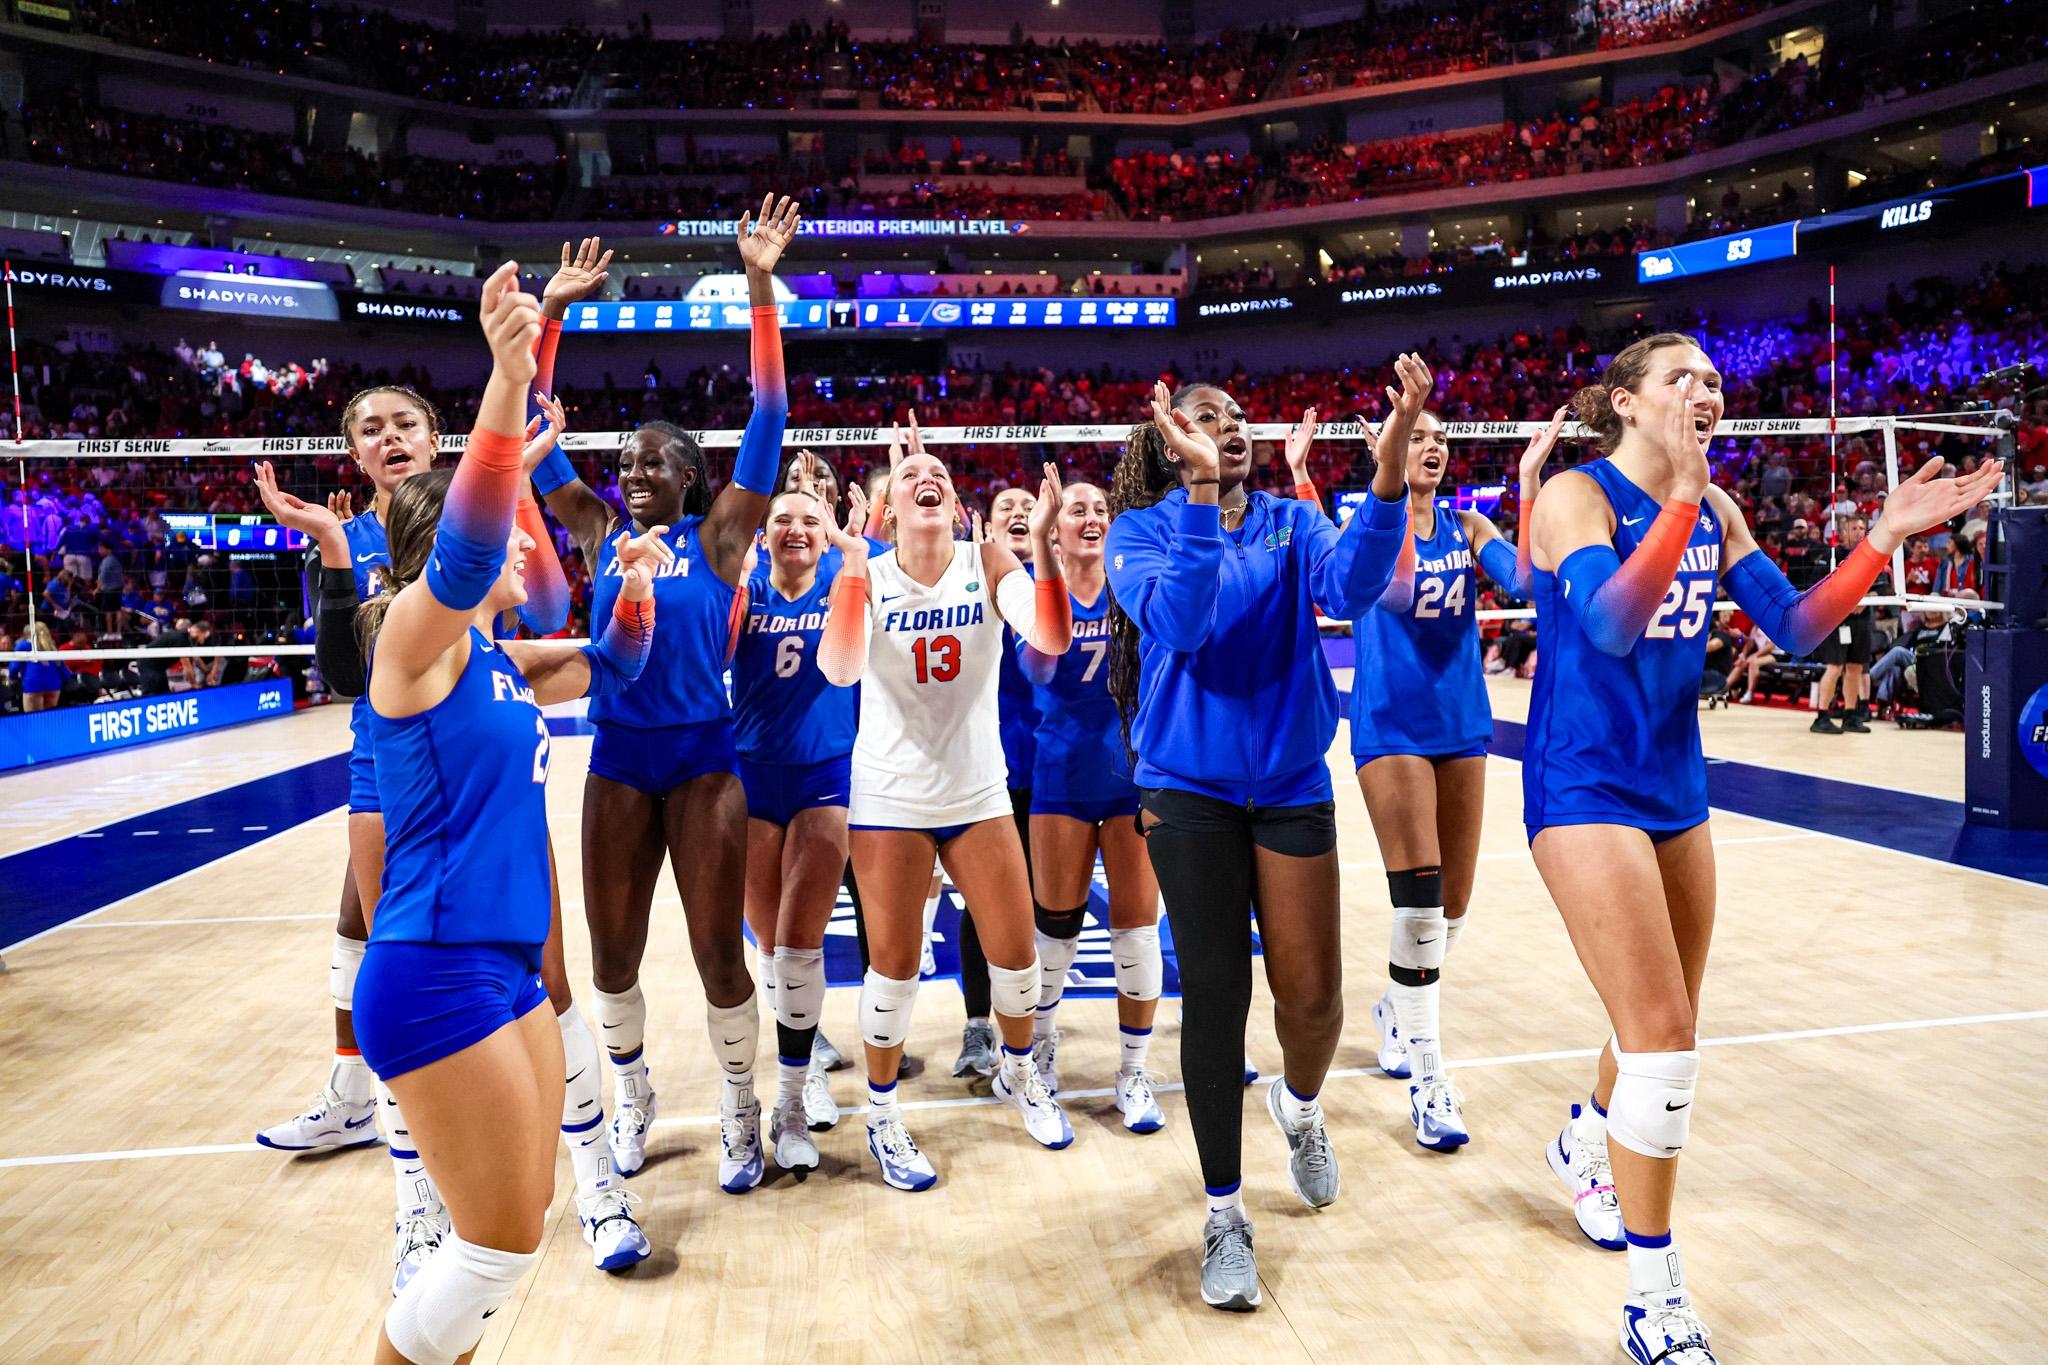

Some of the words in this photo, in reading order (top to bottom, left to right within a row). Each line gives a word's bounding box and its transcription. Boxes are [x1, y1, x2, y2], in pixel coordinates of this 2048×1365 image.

[186, 103, 218, 118] 209
[1881, 200, 1932, 228] KILLS
[795, 220, 874, 235] EXTERIOR
[879, 220, 955, 235] PREMIUM
[959, 220, 1010, 235] LEVEL
[963, 427, 1001, 439] FIRST
[1006, 426, 1048, 438] SERVE
[1291, 424, 1327, 434] FST
[1330, 424, 1364, 434] SERV
[1445, 423, 1478, 433] FIRST
[1482, 423, 1519, 433] SERVE
[1732, 422, 1764, 432] FIRST
[1767, 421, 1801, 431] SERVE
[441, 435, 469, 448] FIR
[792, 429, 831, 442] FIRST
[836, 428, 879, 440] SERVE
[78, 440, 121, 453] FIRST
[124, 440, 171, 452] SERVE
[262, 439, 303, 451] FIRST
[1415, 548, 1473, 574] LORIDA
[1414, 574, 1466, 619] 24
[884, 602, 984, 632] FLORIDA
[1644, 580, 1714, 639] 25
[775, 635, 804, 678] 6
[911, 634, 962, 684] 13
[1080, 640, 1107, 683] 7
[1981, 685, 1992, 718] sports
[88, 706, 142, 744] FIRST
[145, 698, 199, 733] SERVE
[1981, 718, 1992, 759] imports
[411, 1206, 426, 1216] NIKE
[1665, 1296, 1682, 1307] NIKE
